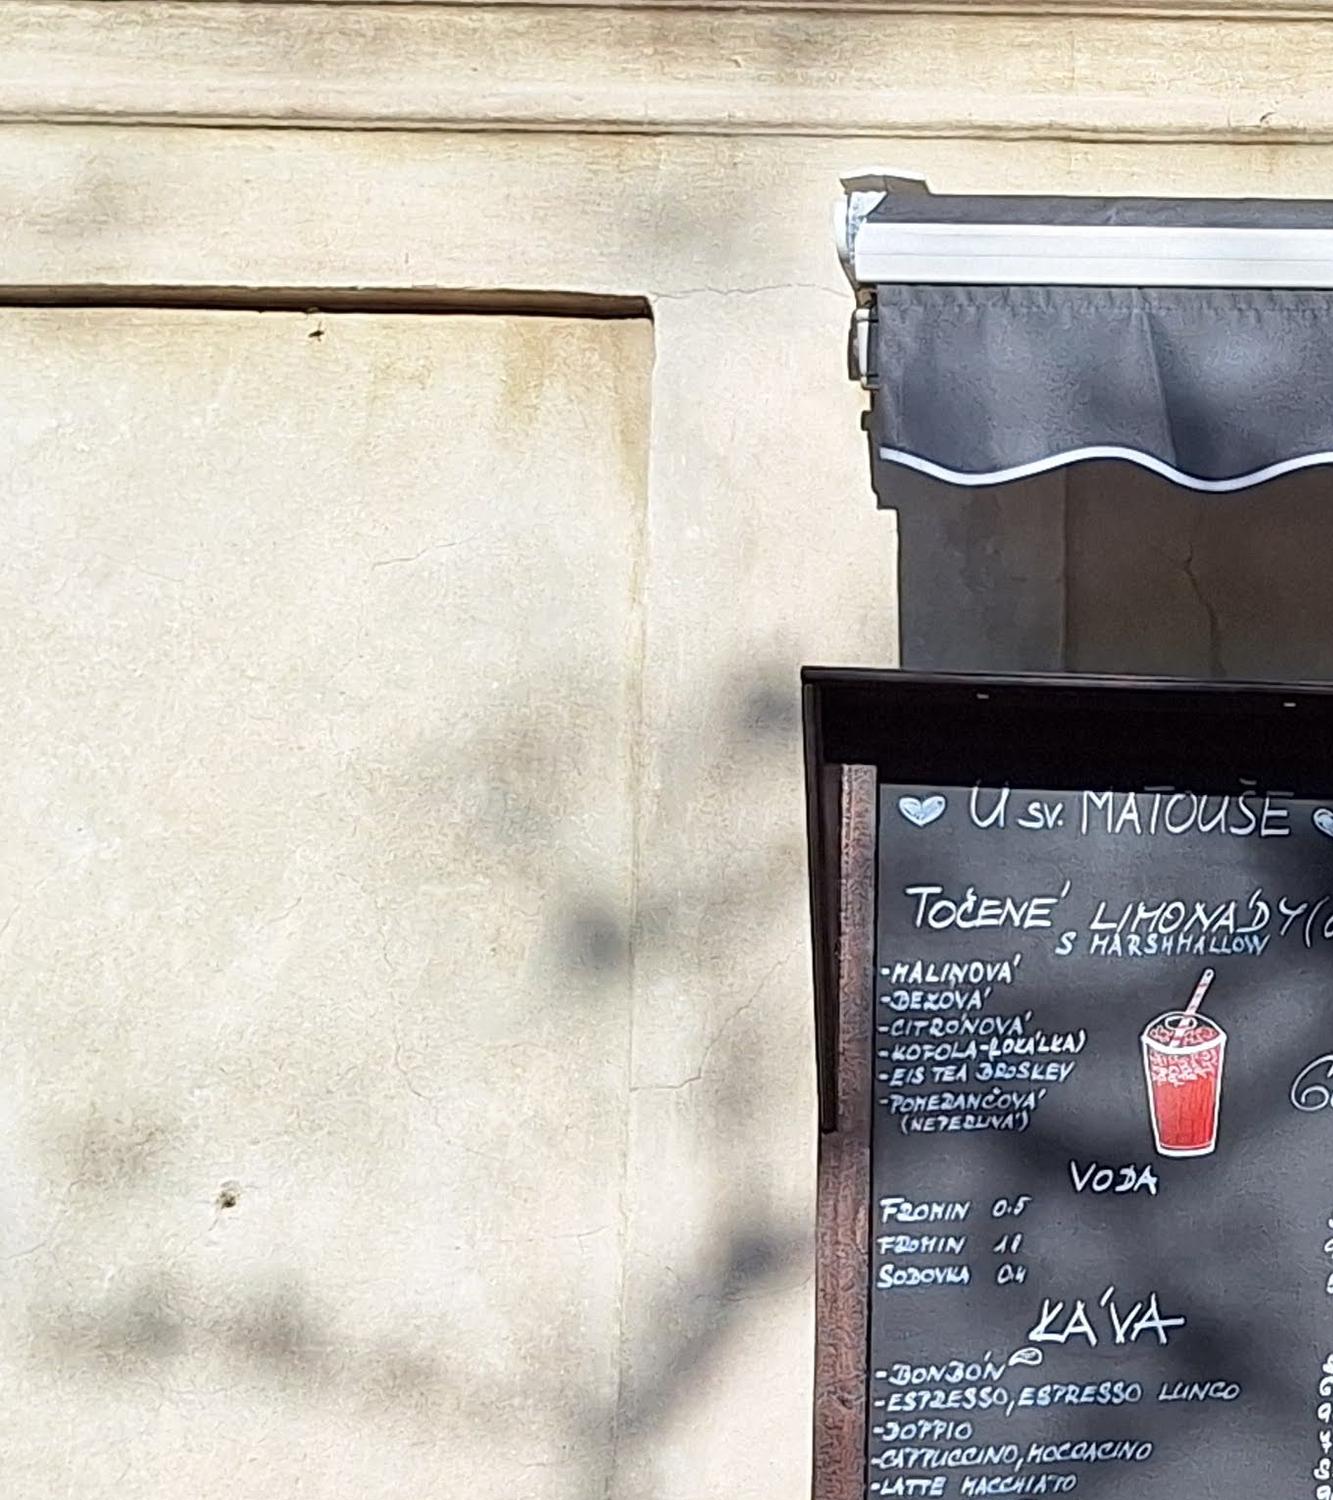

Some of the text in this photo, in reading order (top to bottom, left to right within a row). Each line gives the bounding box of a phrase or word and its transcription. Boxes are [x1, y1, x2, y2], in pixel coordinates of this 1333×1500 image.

[968, 778, 1296, 837] U sv. MATOUŠE
[905, 880, 1071, 929] TOČENÉ
[1054, 931, 1077, 956] S
[931, 1063, 967, 1083] TEA
[1070, 1161, 1158, 1195] VODA
[876, 1263, 970, 1288] SODOVKA
[1028, 1286, 1185, 1347] KÁVA
[960, 1474, 1077, 1497] MACCHIATO
